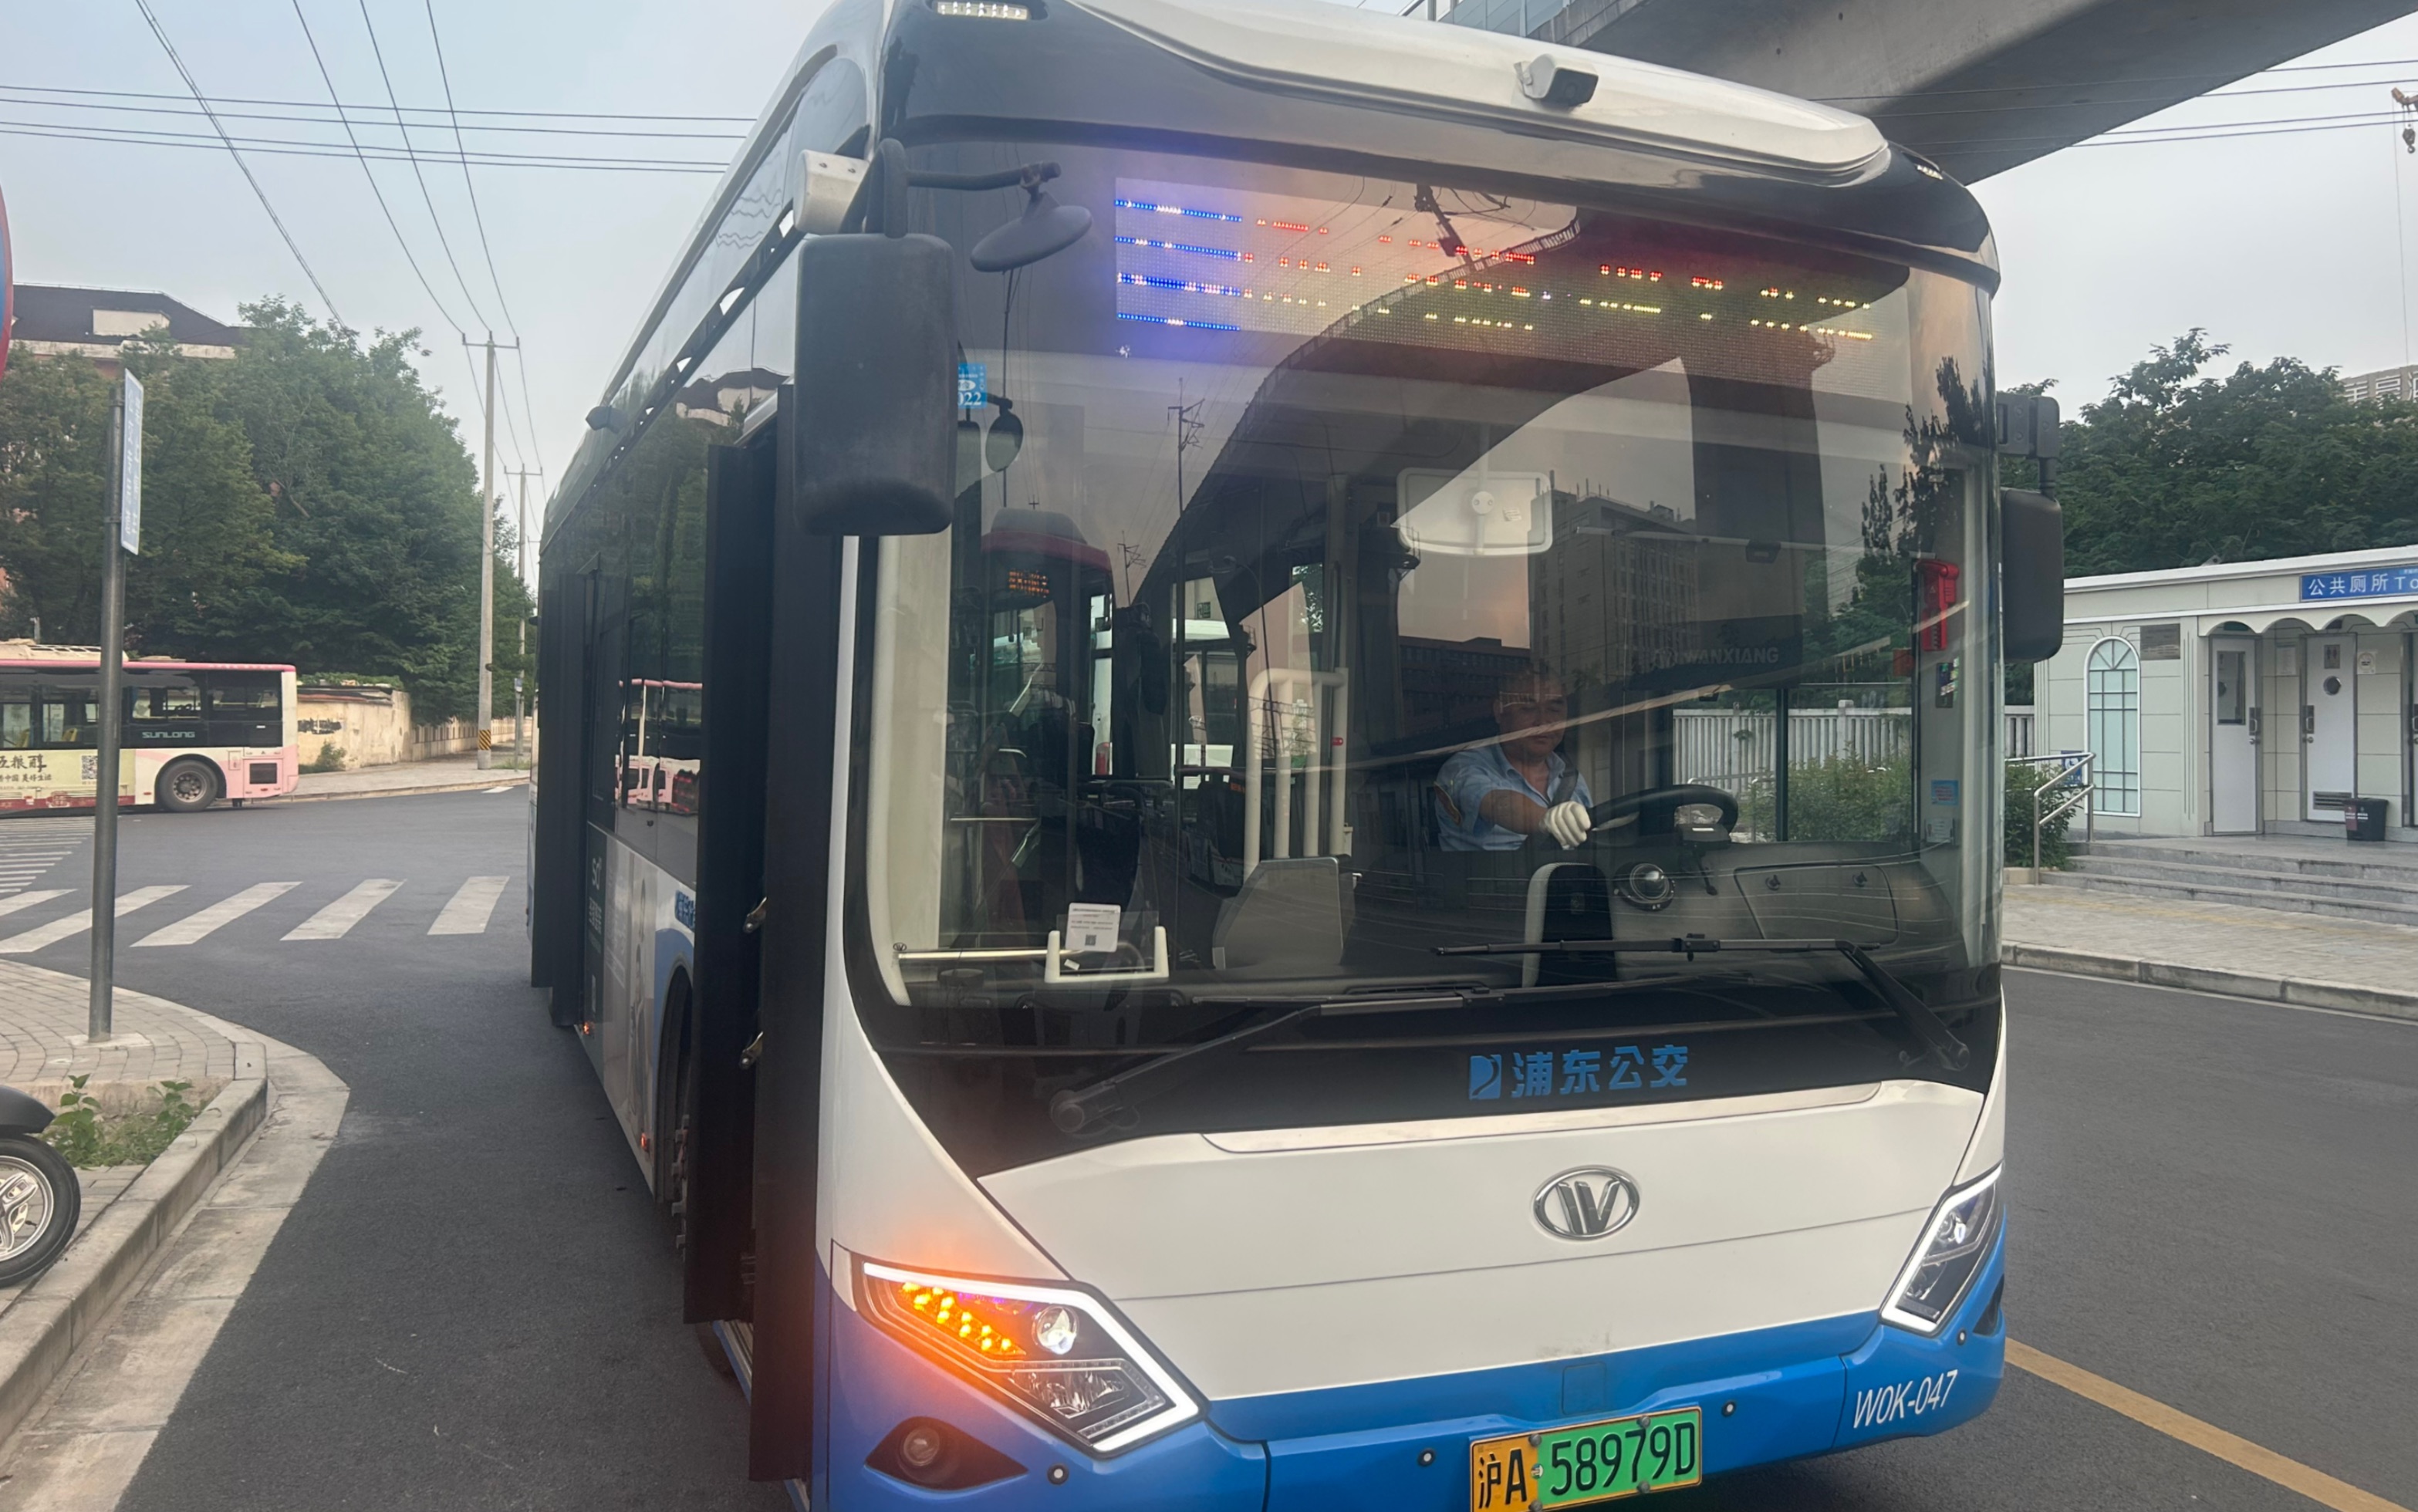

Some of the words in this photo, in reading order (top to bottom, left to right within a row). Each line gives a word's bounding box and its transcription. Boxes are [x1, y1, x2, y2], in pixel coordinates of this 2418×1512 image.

[2308, 573, 2389, 596] 公共厕所
[1511, 1045, 1689, 1099] 浦东公交
[1478, 1448, 1528, 1509] 沪A
[1550, 1421, 1696, 1496] 58979D
